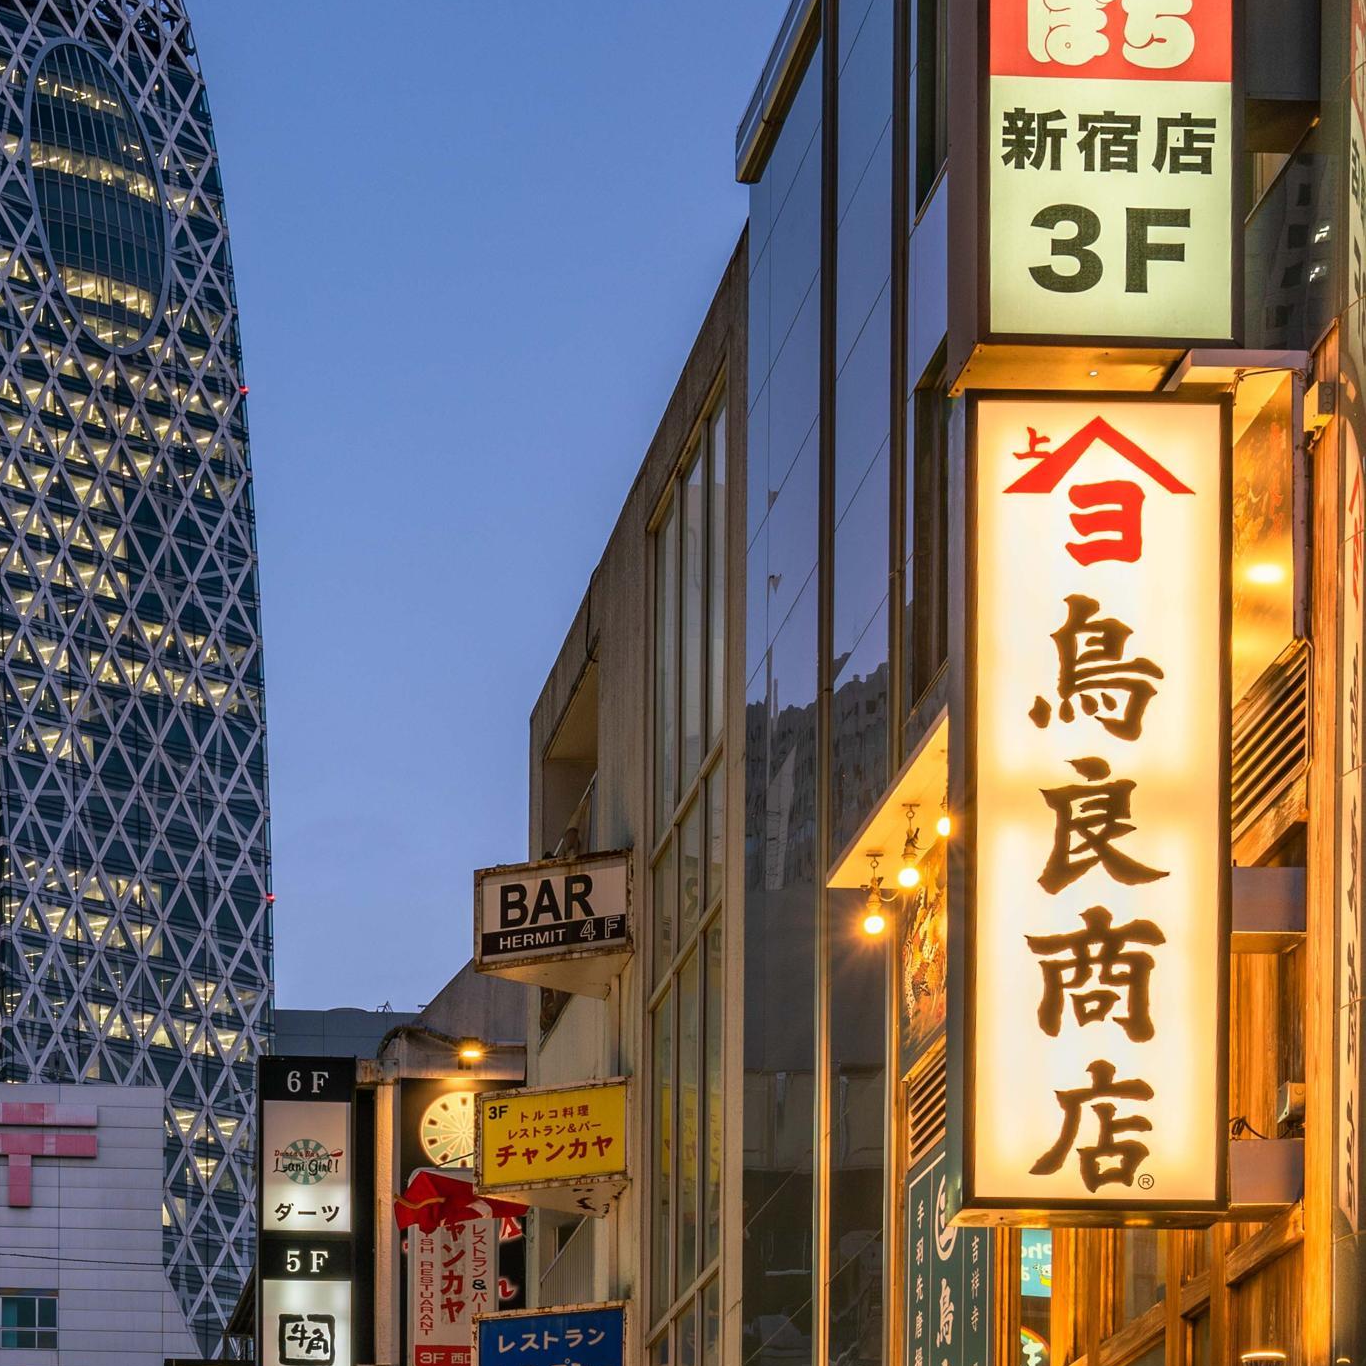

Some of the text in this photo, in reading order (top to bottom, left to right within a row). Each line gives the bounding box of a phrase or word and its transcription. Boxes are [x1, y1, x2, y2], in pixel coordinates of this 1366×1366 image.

[1001, 107, 1216, 176] 新宿店
[1028, 203, 1191, 295] 3F
[500, 873, 595, 929] BAR
[1023, 593, 1171, 1196] 鳥良商店
[499, 915, 620, 950] HERMIT 4F
[287, 1071, 329, 1093] 6F
[488, 1105, 508, 1120] 3F
[520, 1104, 589, 1123] トルコ料理
[508, 1121, 602, 1141] レストラン&バー
[496, 1135, 614, 1168] チャンカヤ
[274, 1202, 340, 1223] ダーツ
[286, 1250, 329, 1273] 5F
[969, 1235, 981, 1333] 吉祥寺
[286, 1323, 329, 1355] 牛角
[498, 1327, 606, 1354] レストラン
